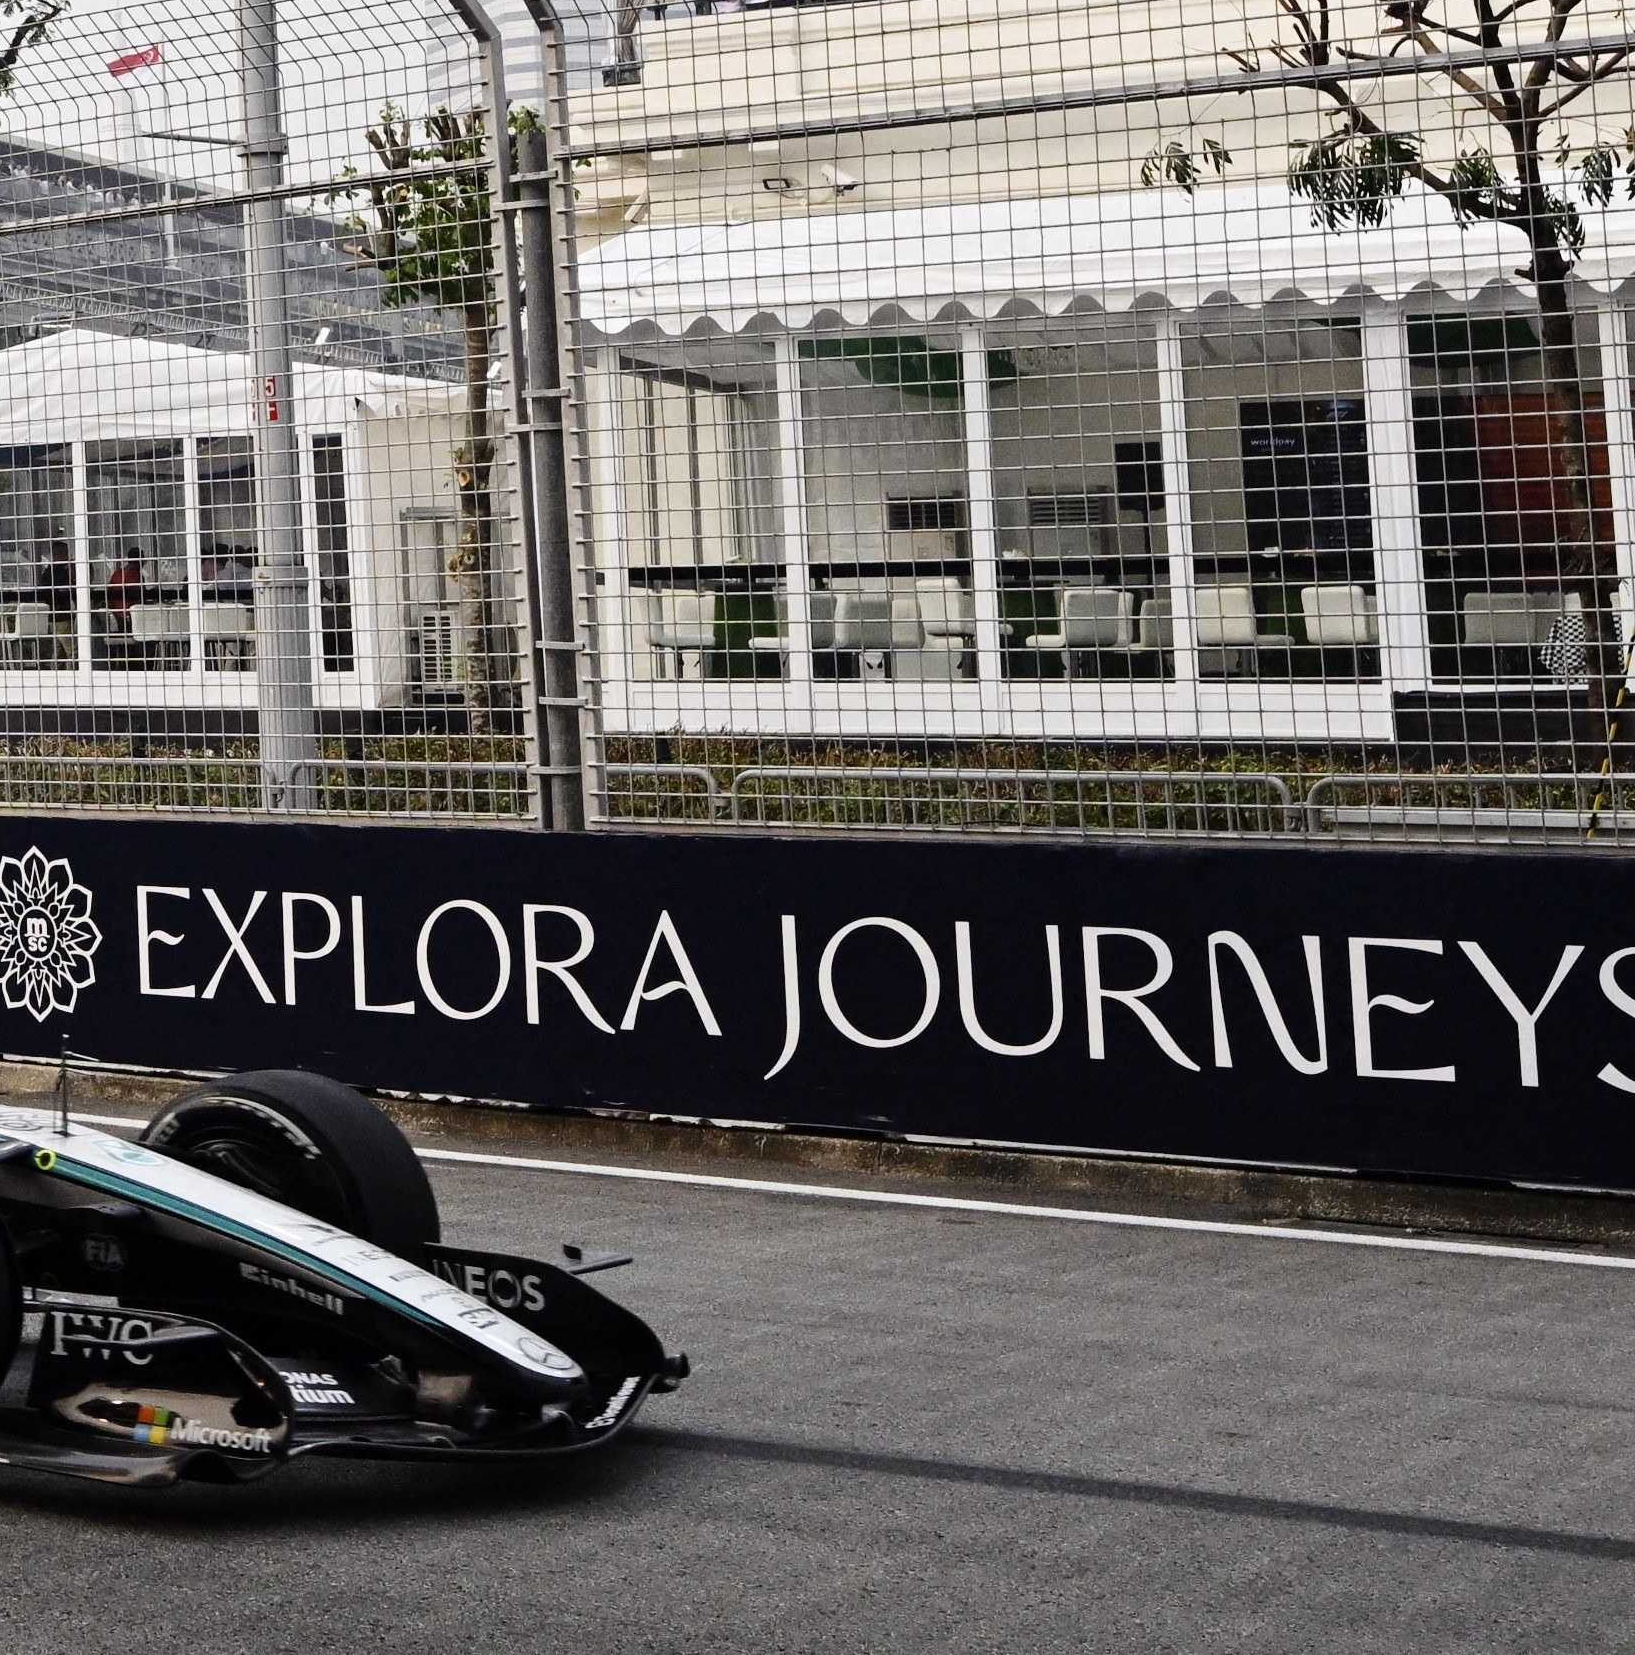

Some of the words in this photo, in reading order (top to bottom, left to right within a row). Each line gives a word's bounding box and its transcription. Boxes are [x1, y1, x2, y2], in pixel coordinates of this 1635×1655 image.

[1251, 437, 1295, 447] wordpay
[136, 884, 723, 1037] EXPLORA
[240, 1262, 344, 1316] Einhell
[170, 1416, 273, 1454] Microsoft
